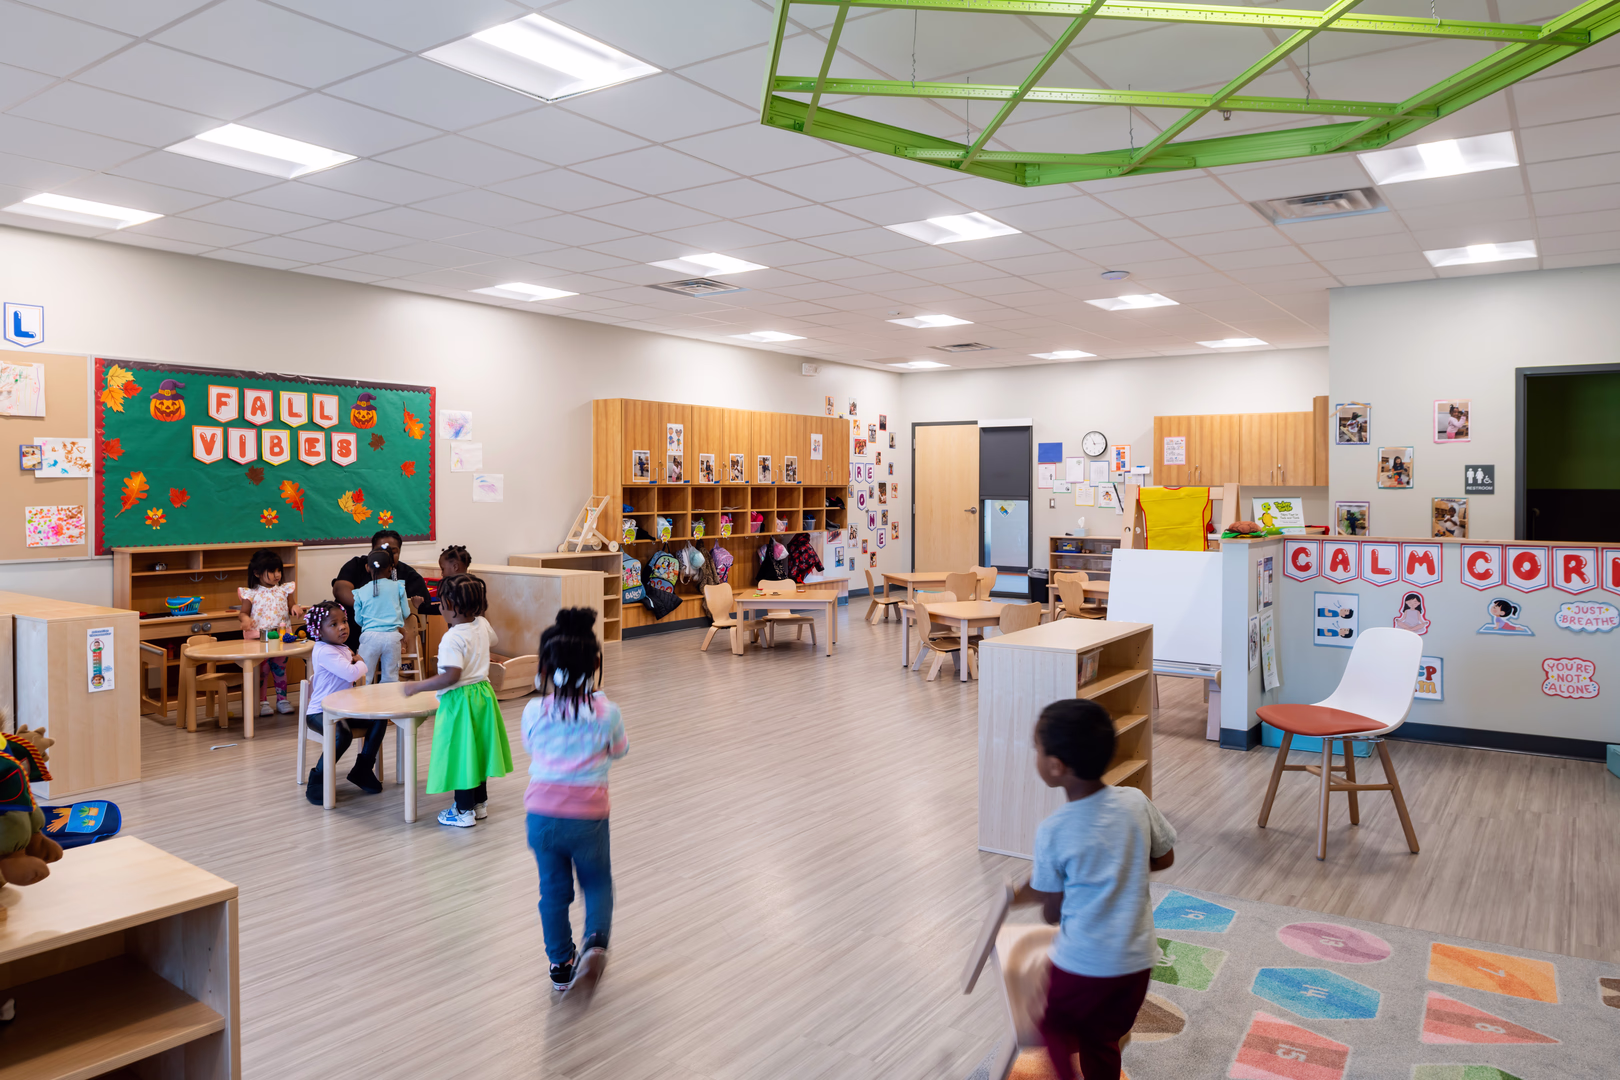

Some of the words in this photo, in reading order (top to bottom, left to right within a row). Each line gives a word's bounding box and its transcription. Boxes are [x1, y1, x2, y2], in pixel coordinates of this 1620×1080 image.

[13, 310, 37, 339] L
[215, 392, 334, 421] FALL
[199, 431, 353, 459] VIBES
[849, 465, 873, 480] RE
[1291, 546, 1436, 576] CALM
[1573, 605, 1604, 615] JUST
[1561, 614, 1617, 626] BREATHE
[1547, 661, 1592, 674] YOU'RE
[1556, 673, 1582, 683] NOT
[1547, 682, 1593, 694] ALONE
[1319, 935, 1346, 948] 13
[1474, 1022, 1507, 1034] 8
[1275, 1043, 1309, 1063] 15
